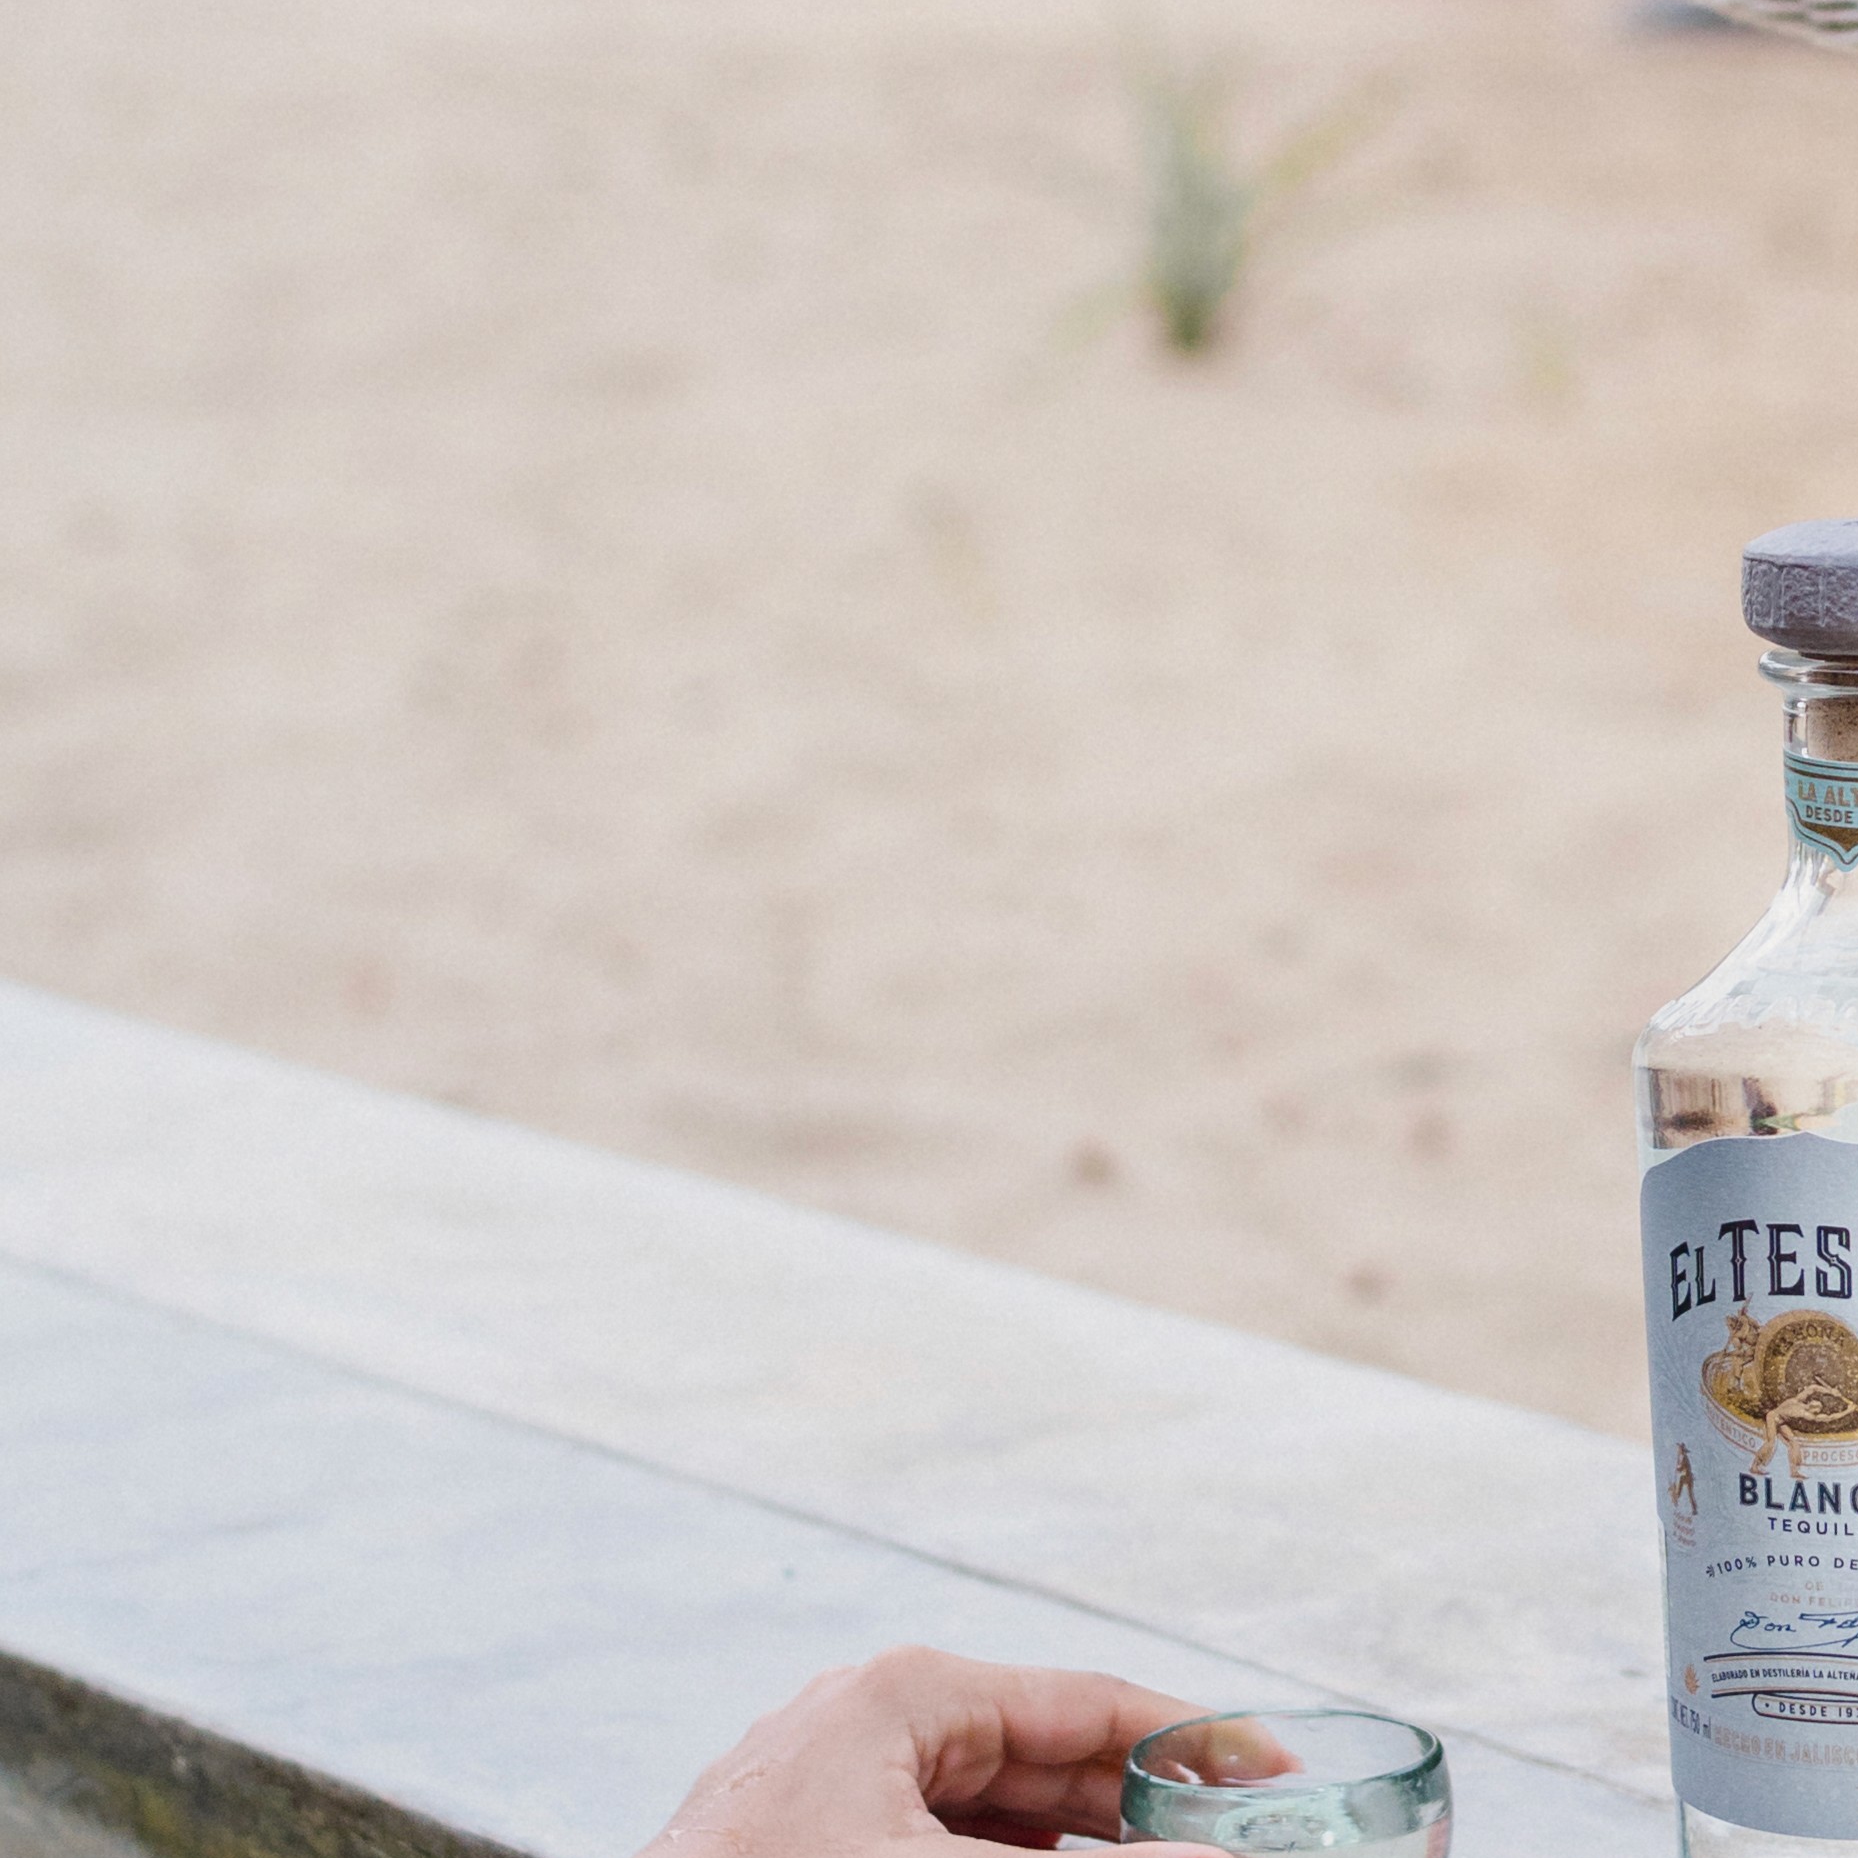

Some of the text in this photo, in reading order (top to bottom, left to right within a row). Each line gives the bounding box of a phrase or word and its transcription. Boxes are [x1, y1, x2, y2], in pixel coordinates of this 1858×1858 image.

[1798, 780, 1817, 803] LA
[1805, 805, 1854, 825] DESDE
[1670, 1241, 1716, 1322] EL
[1717, 1556, 1757, 1575] 100%
[1767, 1555, 1821, 1567] PURO
[1769, 1591, 1801, 1604] DON
[1711, 1669, 1748, 1683] ELABORADO
[1750, 1668, 1760, 1679] EN
[1812, 1669, 1824, 1679] LA
[1778, 1704, 1827, 1718] DESDE
